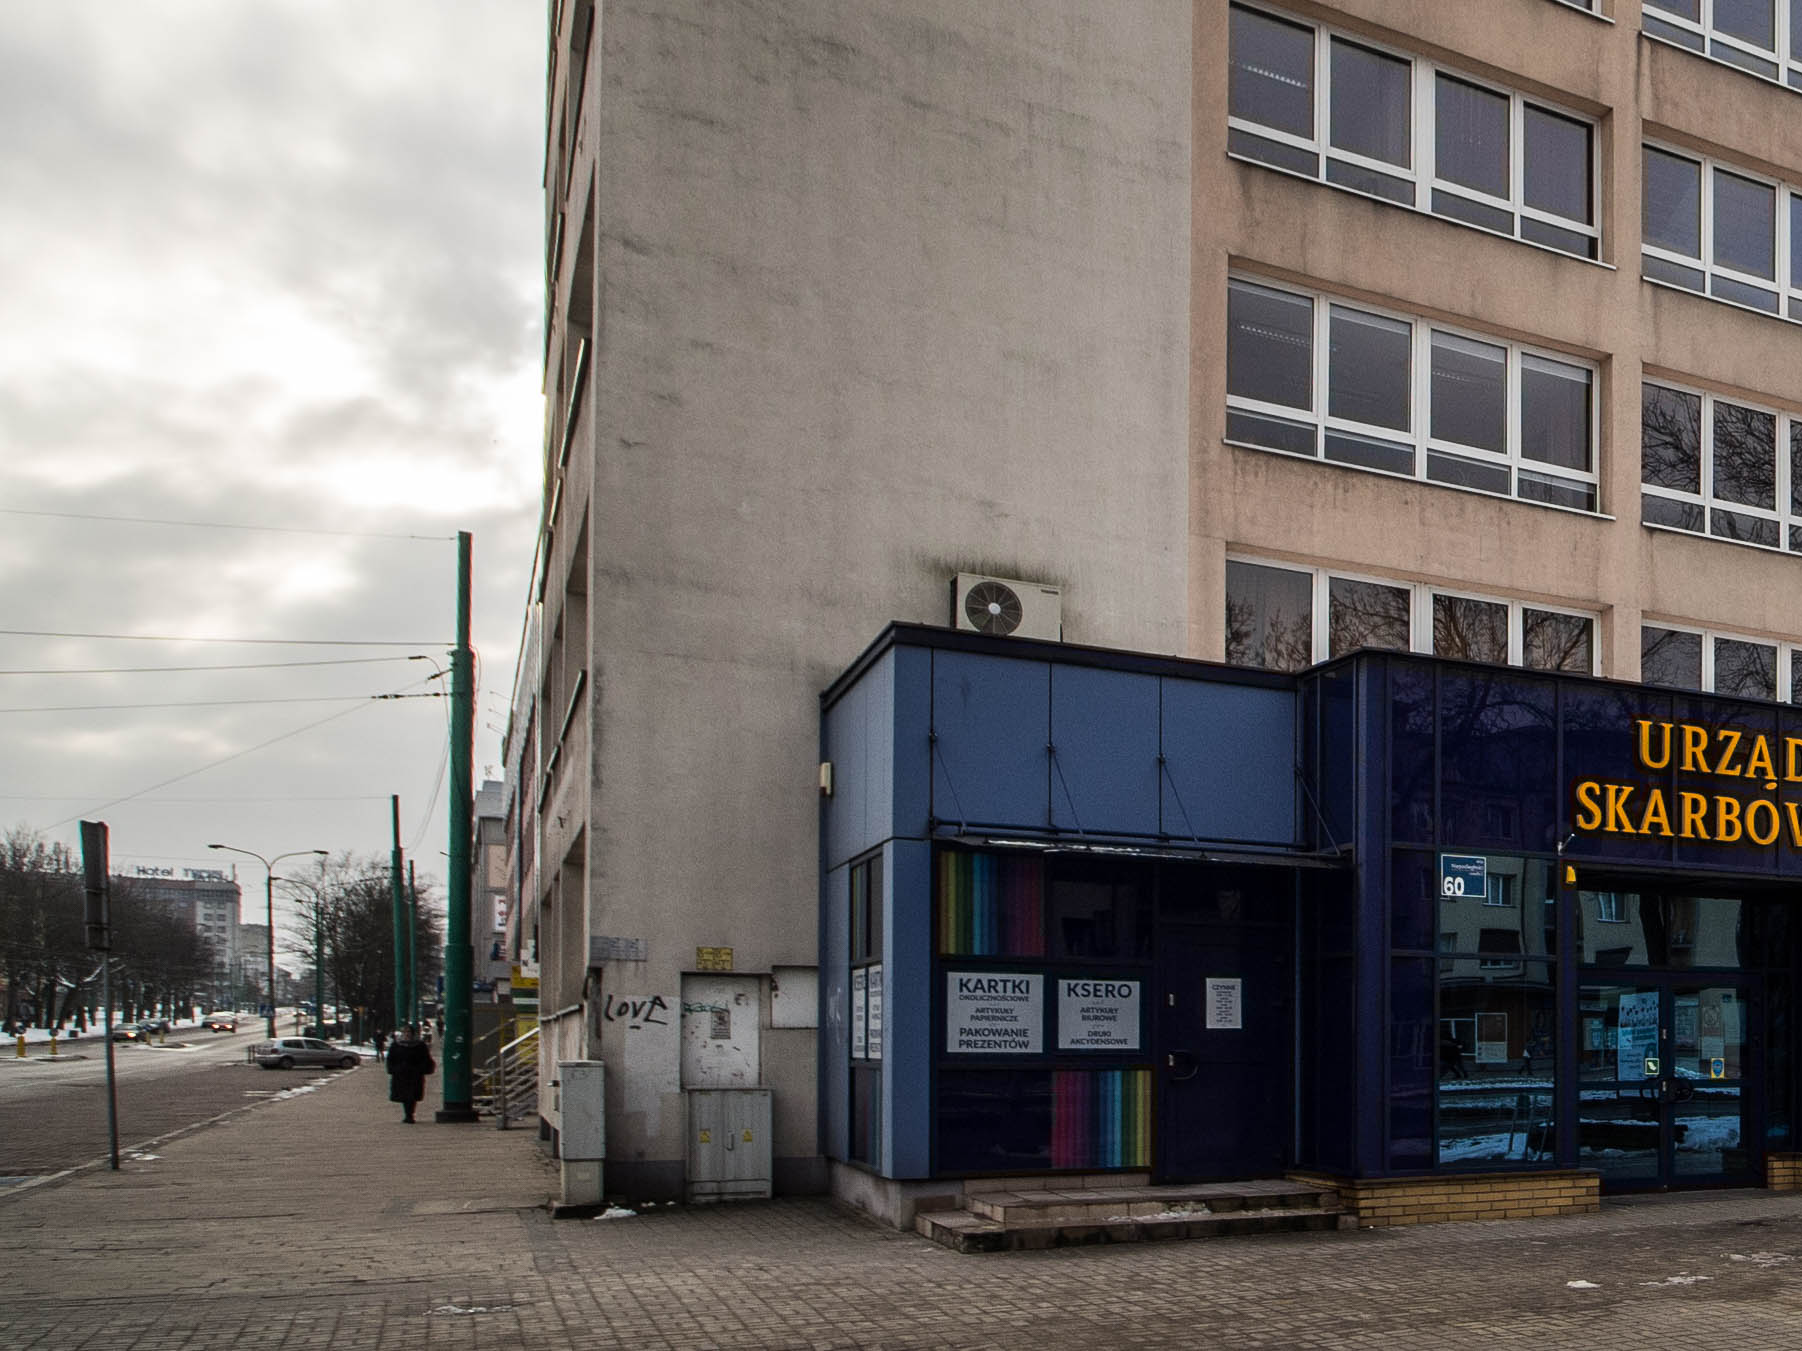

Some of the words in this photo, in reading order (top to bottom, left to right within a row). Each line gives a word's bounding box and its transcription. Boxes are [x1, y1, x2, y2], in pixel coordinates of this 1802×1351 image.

[136, 865, 173, 877] Hotel
[1444, 876, 1465, 896] 60
[959, 978, 1030, 995] KARTKI
[1067, 982, 1132, 999] KSERO
[960, 1028, 1030, 1038] PAKOWANIE
[959, 1037, 1030, 1049] PREZENTÓW
